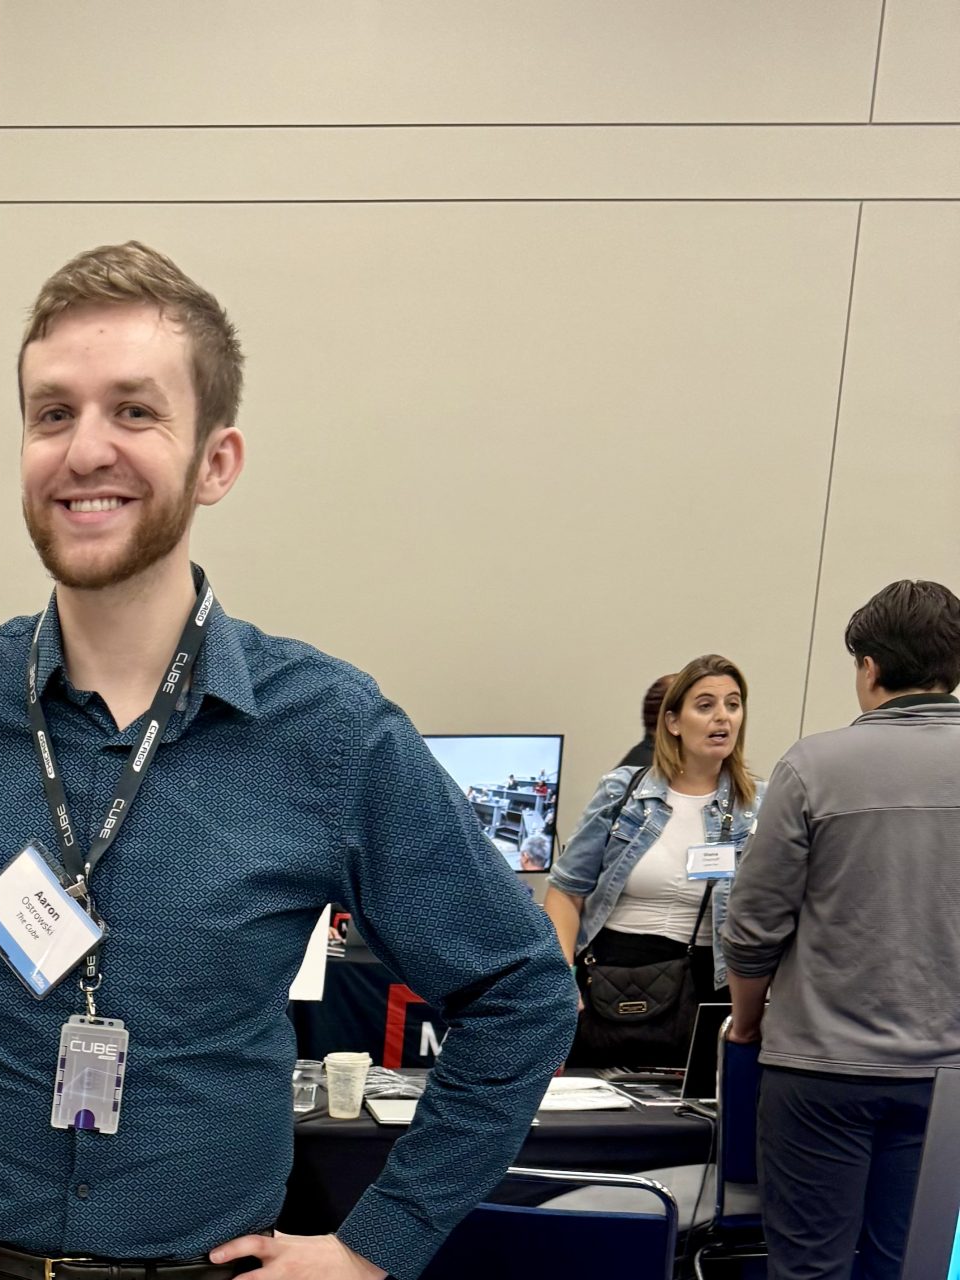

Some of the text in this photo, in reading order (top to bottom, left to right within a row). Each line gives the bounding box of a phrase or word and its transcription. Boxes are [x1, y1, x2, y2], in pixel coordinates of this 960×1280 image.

[162, 652, 188, 694] CUBE
[135, 724, 157, 767] CHICAGO
[57, 804, 74, 846] CUBE
[99, 798, 124, 838] CUBE
[21, 896, 54, 936] Ostrowski
[34, 891, 61, 921] Aaron
[25, 922, 39, 940] Cube
[70, 1040, 118, 1056] CUBE
